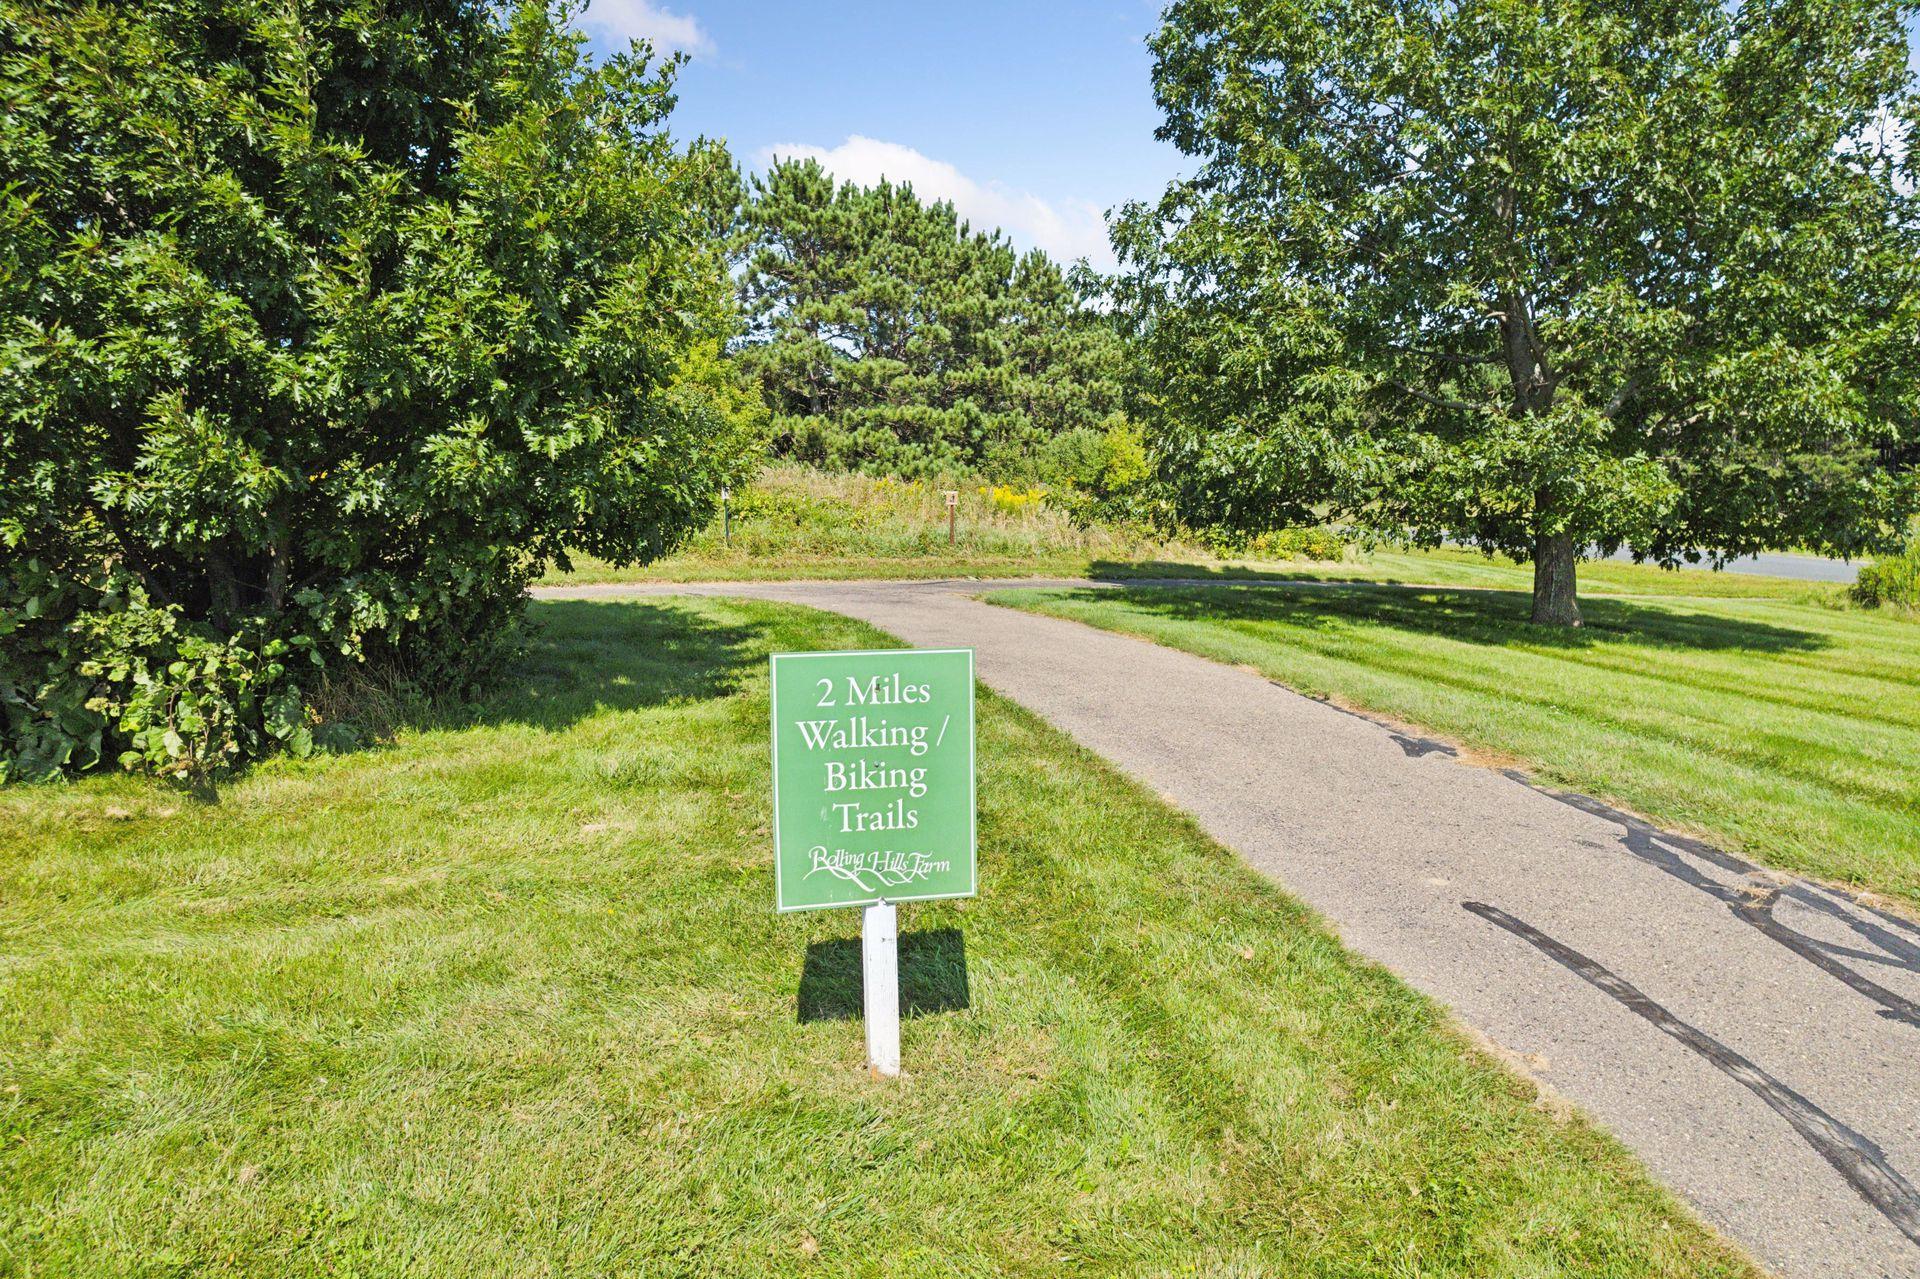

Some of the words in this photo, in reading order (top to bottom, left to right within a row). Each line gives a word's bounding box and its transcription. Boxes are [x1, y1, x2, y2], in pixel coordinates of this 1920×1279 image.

[816, 677, 836, 707] 2
[844, 672, 931, 706] Miles
[795, 716, 929, 756] Walking
[824, 759, 928, 798] Biking
[832, 799, 919, 833] Trails
[807, 845, 864, 875] Rolling
[867, 850, 908, 873] Hills
[907, 850, 950, 874] Farm
